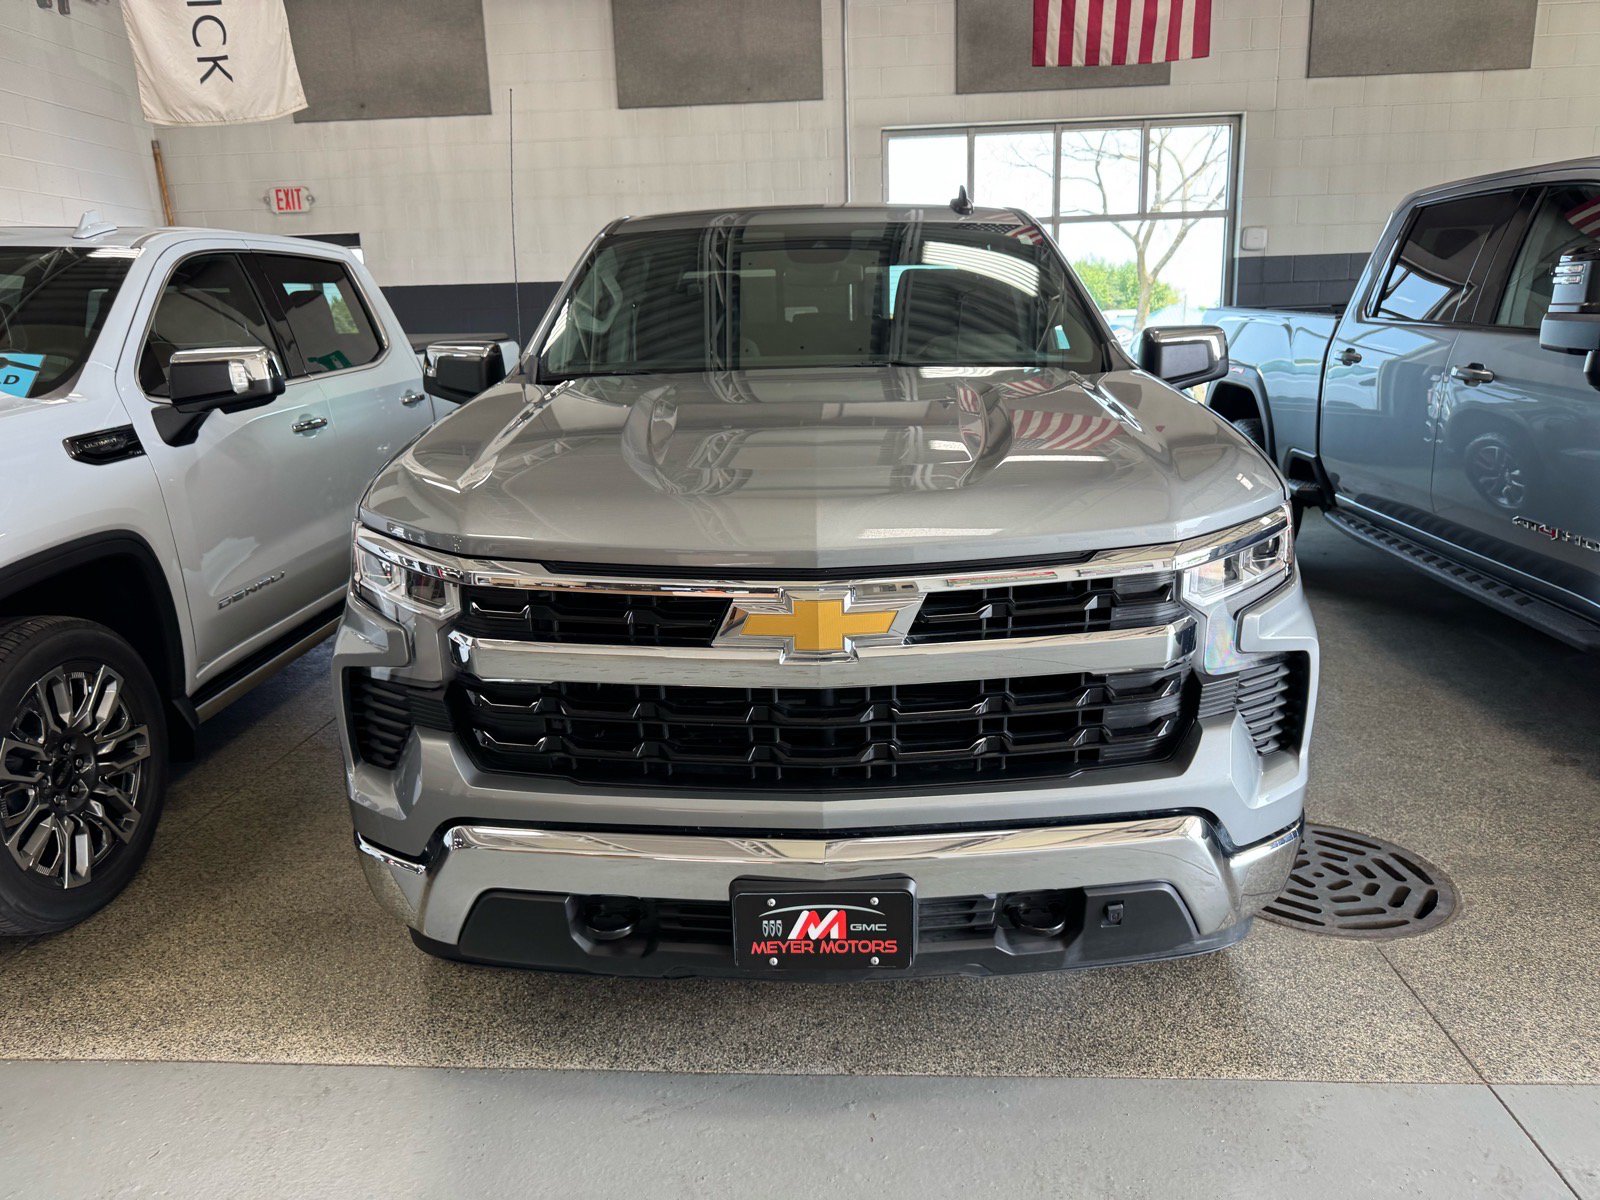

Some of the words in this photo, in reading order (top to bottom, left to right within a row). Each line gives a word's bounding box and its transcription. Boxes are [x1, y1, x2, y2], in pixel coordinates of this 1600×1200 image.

[275, 188, 302, 210] EXIT
[217, 569, 286, 611] DENALI
[850, 923, 887, 932] GMC
[751, 940, 815, 954] MEYER
[820, 939, 898, 954] MOTORS
